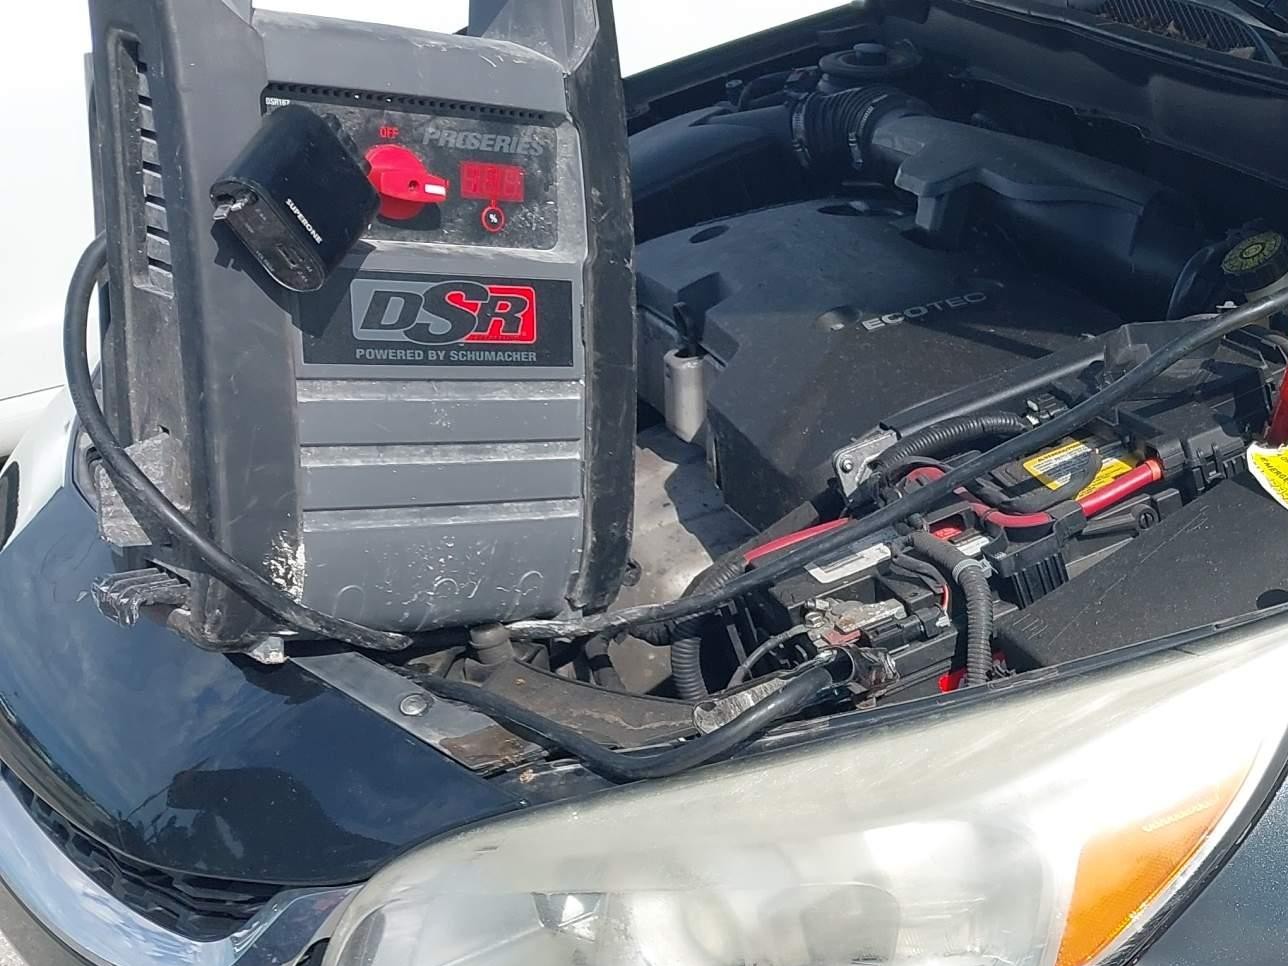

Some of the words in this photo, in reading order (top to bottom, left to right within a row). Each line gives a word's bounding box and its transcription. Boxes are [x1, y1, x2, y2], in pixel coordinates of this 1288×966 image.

[379, 126, 399, 139] OFF
[285, 198, 324, 245] SUPERONE
[359, 279, 529, 346] DSR
[861, 291, 987, 332] ECOTEC
[355, 348, 424, 361] POWERED
[428, 349, 446, 362] BY
[450, 350, 537, 363] SCHUMACHER
